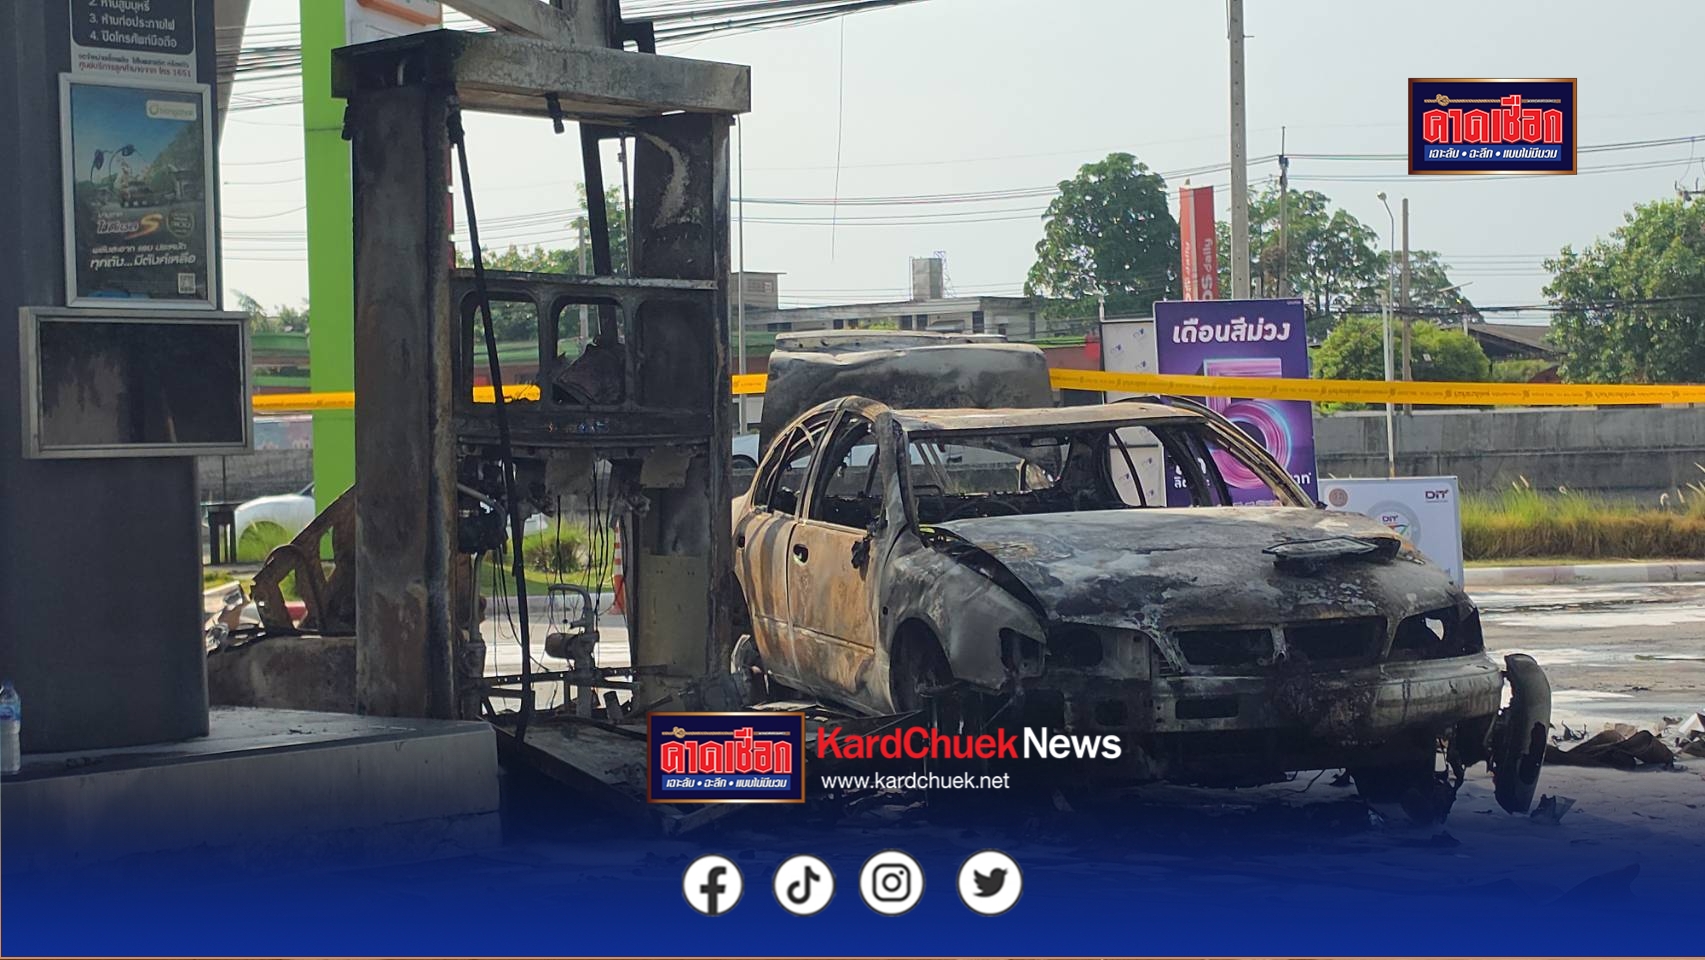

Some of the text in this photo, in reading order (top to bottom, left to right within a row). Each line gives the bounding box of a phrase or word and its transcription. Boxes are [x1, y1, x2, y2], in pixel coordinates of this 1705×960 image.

[101, 0, 150, 14] หามสูบบุหรี
[1172, 316, 1291, 344] เดือนสีม่วง
